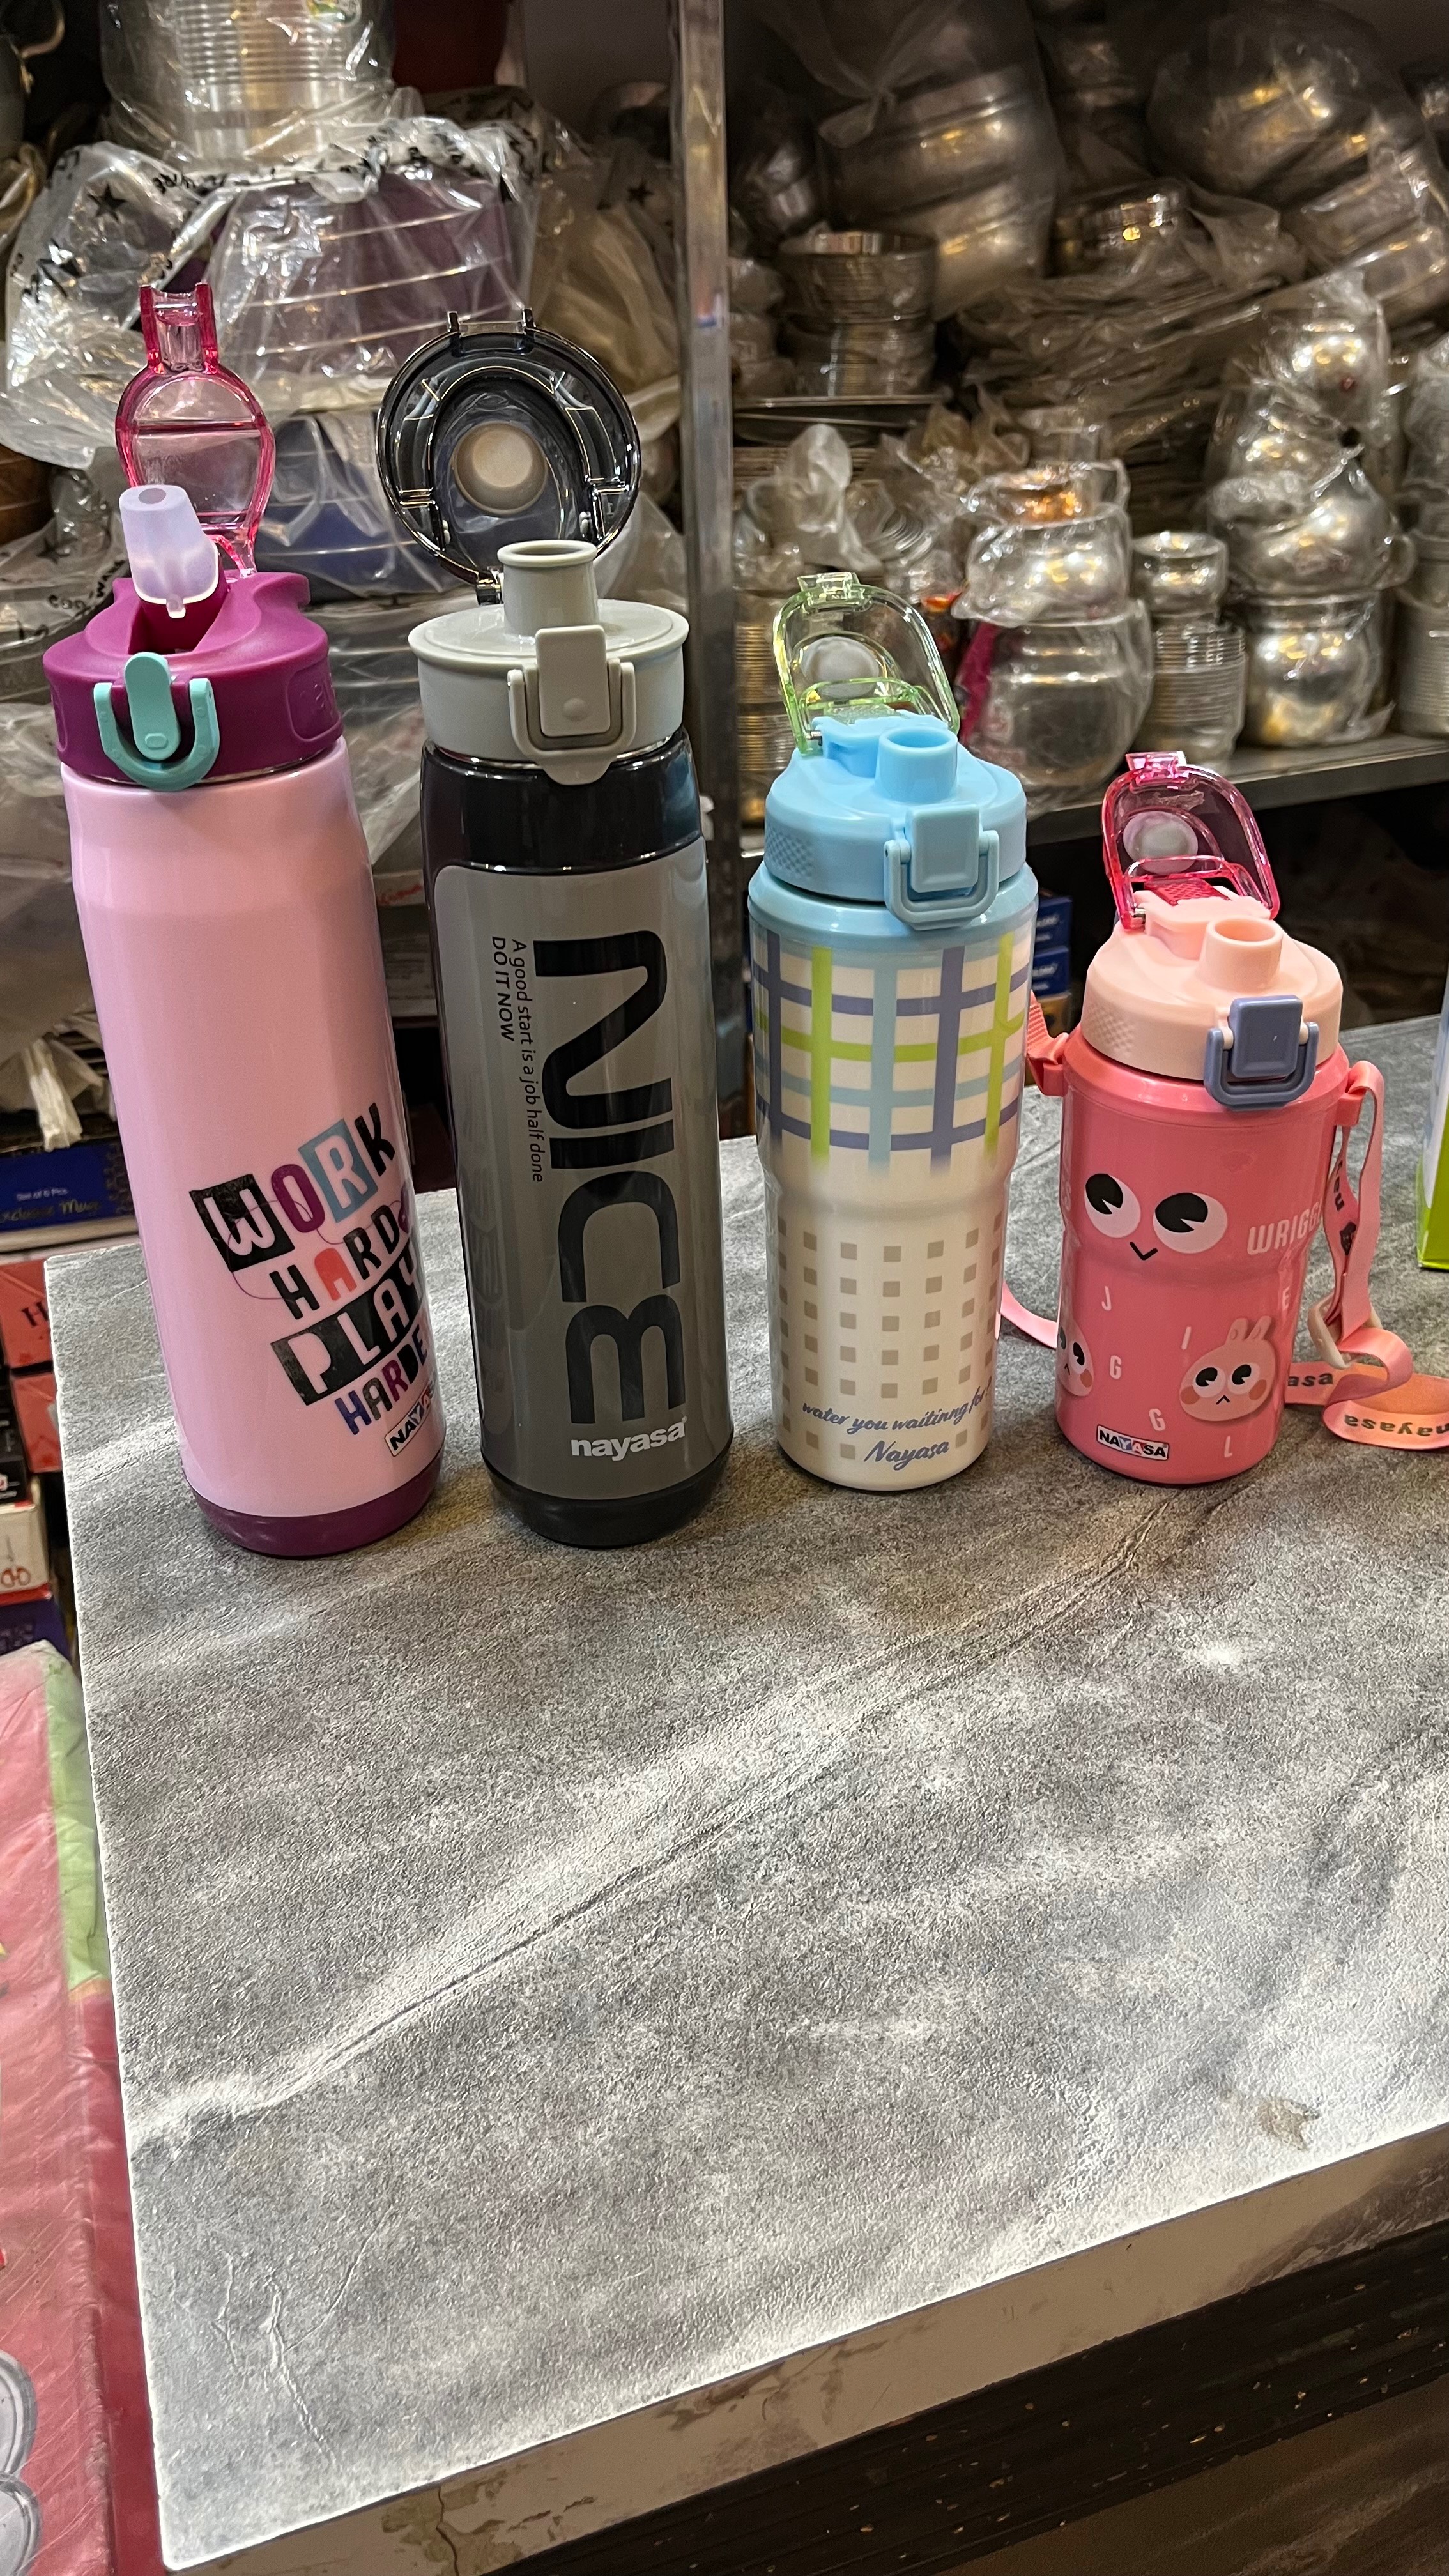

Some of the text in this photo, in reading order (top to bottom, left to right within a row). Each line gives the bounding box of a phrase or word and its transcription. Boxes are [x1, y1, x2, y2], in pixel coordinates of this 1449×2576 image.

[492, 936, 515, 1042] DO IT NOW
[509, 939, 545, 1182] A good start is a job half done
[201, 1103, 395, 1259] WORK
[269, 1205, 400, 1319] HARD
[287, 1241, 422, 1395] PLAY
[334, 1317, 429, 1435] HARDE
[390, 1379, 434, 1452] NAYAS
[802, 1402, 850, 1425] water
[846, 1417, 888, 1435] you
[571, 1422, 686, 1461] nayasa
[864, 1439, 950, 1471] Nayasa
[1100, 1429, 1166, 1457] NAYASA
